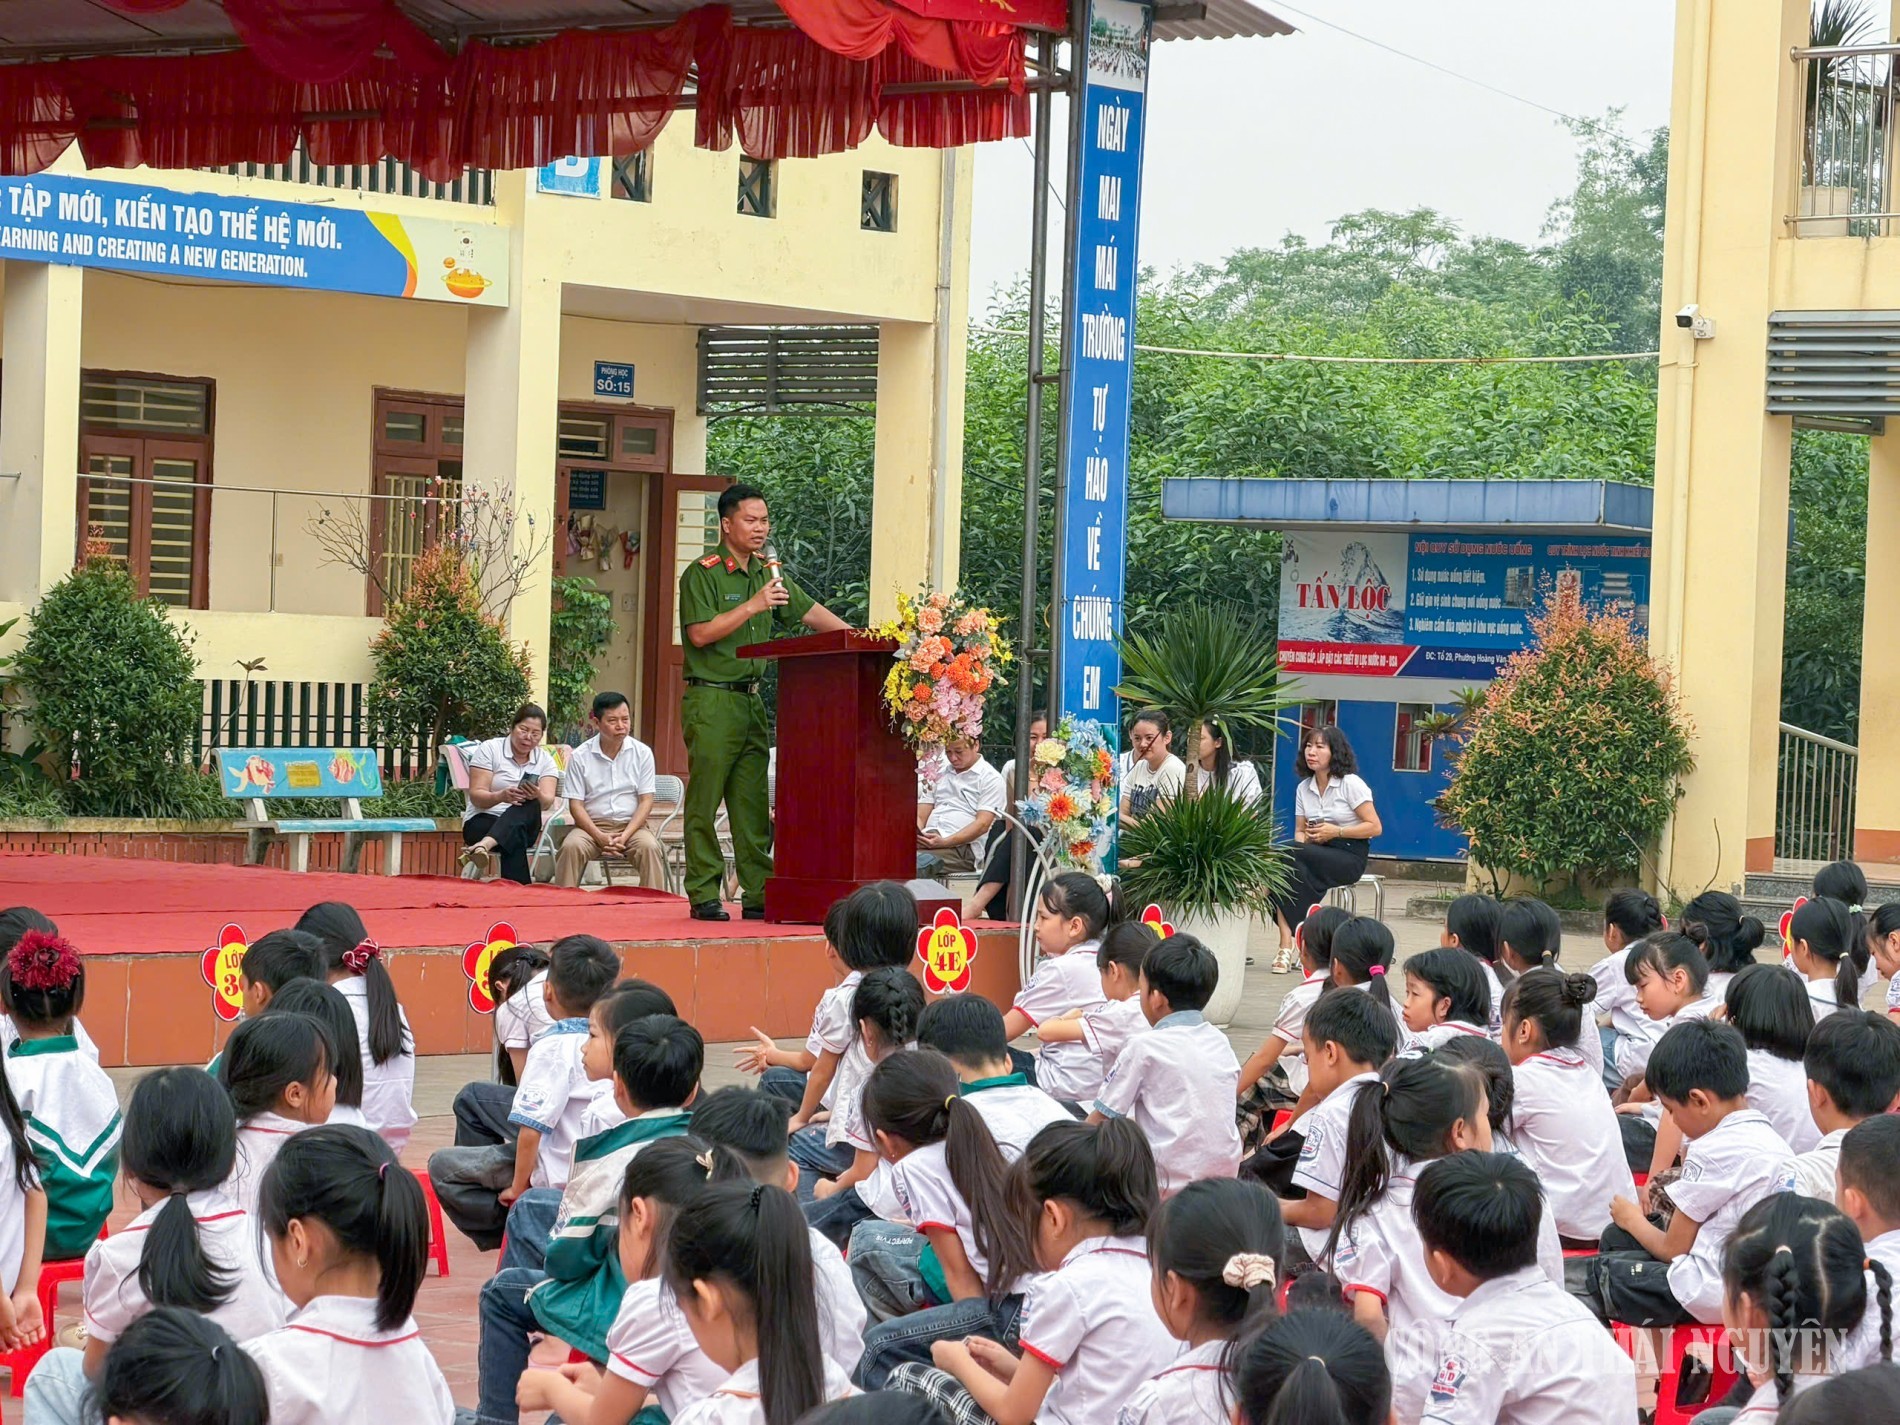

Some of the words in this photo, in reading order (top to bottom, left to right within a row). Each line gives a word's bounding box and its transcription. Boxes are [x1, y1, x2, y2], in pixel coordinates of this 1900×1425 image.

[1097, 96, 1129, 152] NGÀY
[9, 182, 51, 223] TẬP
[58, 189, 108, 228] MỚI,
[115, 194, 166, 230] KIẾN
[172, 205, 213, 240] TẠO
[220, 205, 259, 240] THẾ
[264, 212, 290, 249] HỆ
[297, 216, 342, 249] MỚI.
[1098, 174, 1121, 222] MAI
[0, 226, 58, 253] ARNING
[63, 232, 93, 256] AND
[98, 236, 166, 264] CREATING
[170, 243, 180, 265] A
[184, 244, 217, 269] NEW
[221, 249, 308, 278] GENERATION.
[1094, 235, 1118, 291] MÁI
[1082, 303, 1126, 361] TRƯỜNG
[597, 375, 631, 393] SỐ:15
[601, 366, 617, 376] PHÒNG
[618, 368, 629, 380] HỌC
[1092, 383, 1108, 443] TỰ
[1085, 447, 1108, 502] HÀO
[1087, 511, 1103, 571] VỀ
[1414, 539, 1429, 556] NỘI
[1430, 542, 1448, 554] QUY
[1448, 539, 1461, 554] SỬ
[1461, 542, 1484, 557] DỤNG
[1485, 541, 1508, 555] NƯỚC
[1509, 540, 1532, 556] UỐNG
[1072, 584, 1113, 641] CHÚNG
[1296, 571, 1340, 609] TẤN
[1347, 578, 1392, 620] LỘC
[1454, 652, 1476, 665] Phường
[1083, 665, 1100, 710] EM
[934, 950, 962, 972] 4E
[938, 931, 956, 948] LỚP
[224, 973, 243, 997] 3
